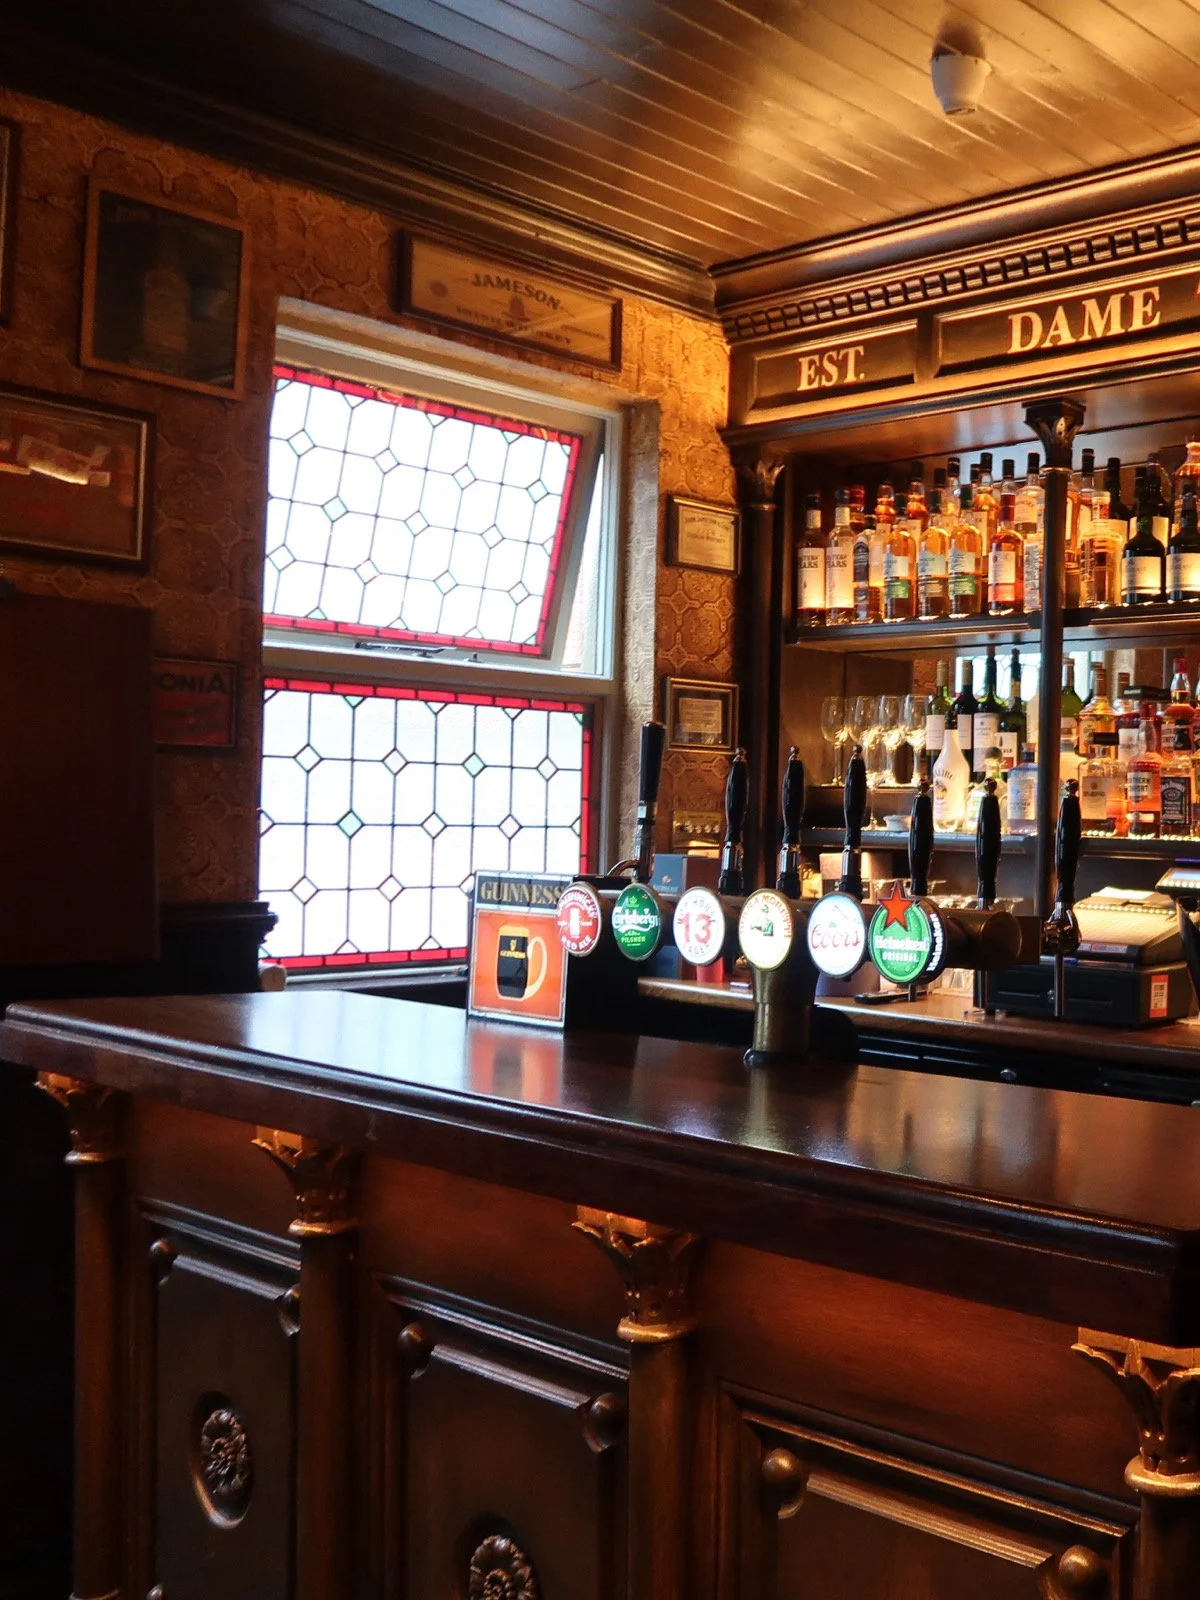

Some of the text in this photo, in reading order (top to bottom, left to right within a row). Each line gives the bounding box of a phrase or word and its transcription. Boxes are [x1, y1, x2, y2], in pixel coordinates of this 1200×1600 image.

[471, 273, 561, 310] JAMESON
[1007, 286, 1161, 354] DAME
[797, 345, 865, 391] EST.
[481, 881, 564, 905] GUINNESS
[678, 912, 712, 944] 13
[811, 923, 860, 949] Coors
[926, 913, 943, 971] Heineken
